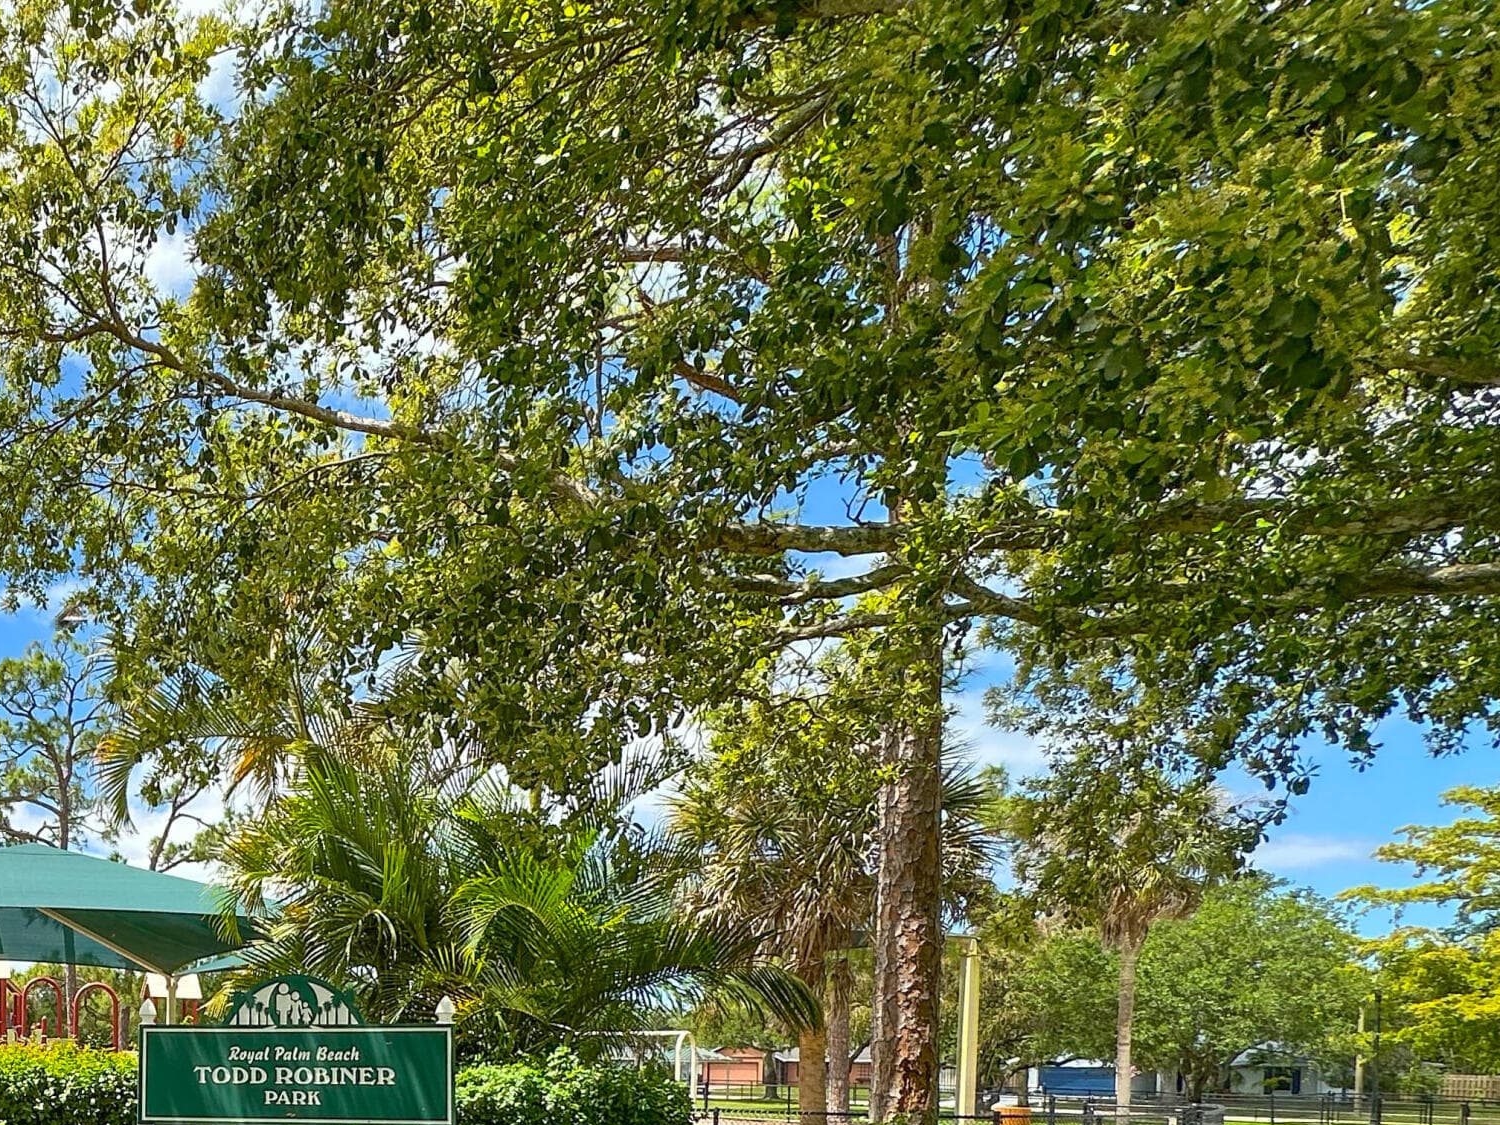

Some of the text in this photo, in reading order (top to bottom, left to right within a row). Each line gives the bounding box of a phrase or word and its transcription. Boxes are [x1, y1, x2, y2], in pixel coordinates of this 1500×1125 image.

[228, 1047, 360, 1064] Royal Palm Beach
[193, 1066, 396, 1085] TODD ROBINER
[264, 1090, 321, 1106] PARK
